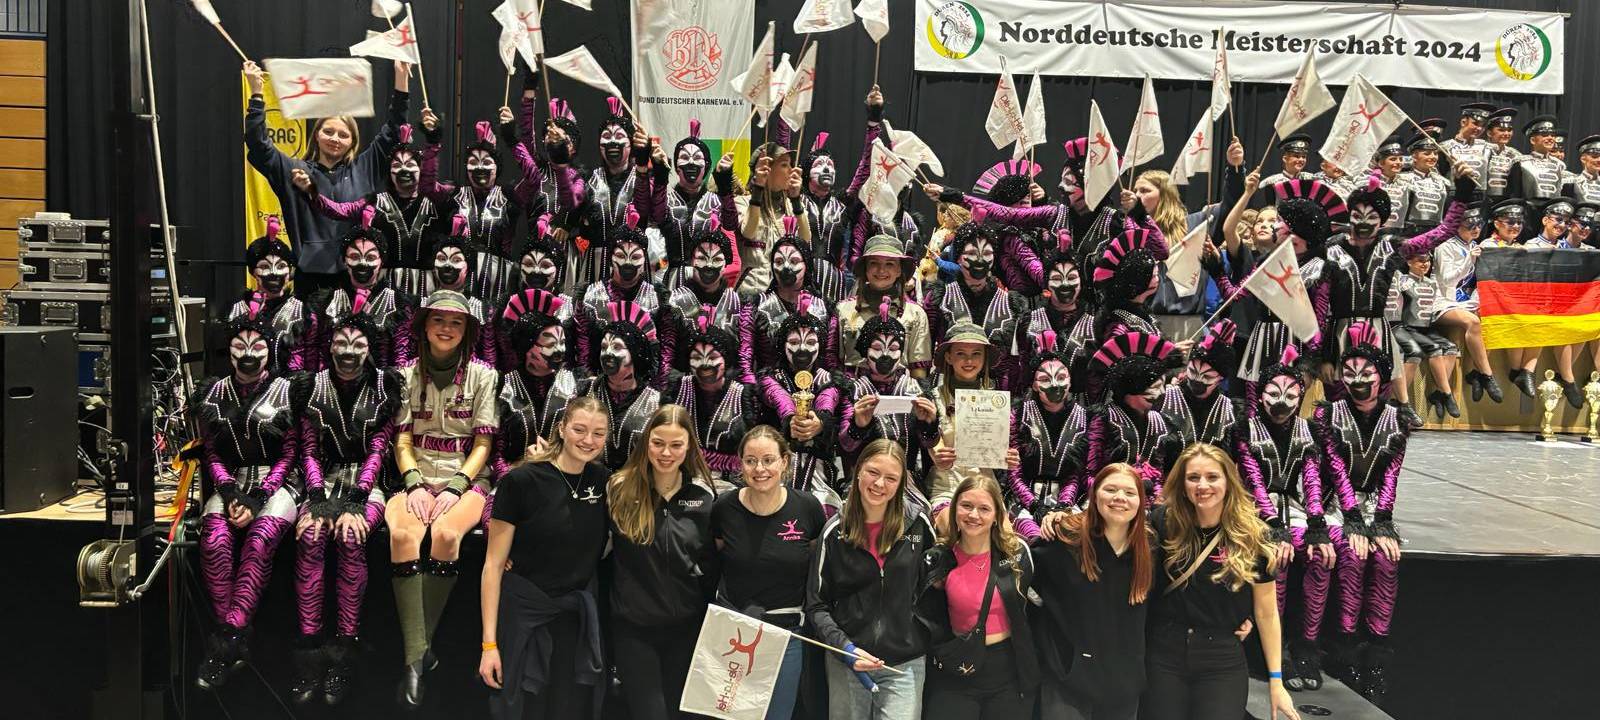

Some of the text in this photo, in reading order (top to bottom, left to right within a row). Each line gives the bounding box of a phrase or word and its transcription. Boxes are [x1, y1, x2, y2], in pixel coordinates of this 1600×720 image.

[999, 21, 1482, 63] Norddeutsche Meisterschaft 2024
[656, 97, 695, 105] DEUTSCHER
[697, 98, 731, 106] KARNEVAL
